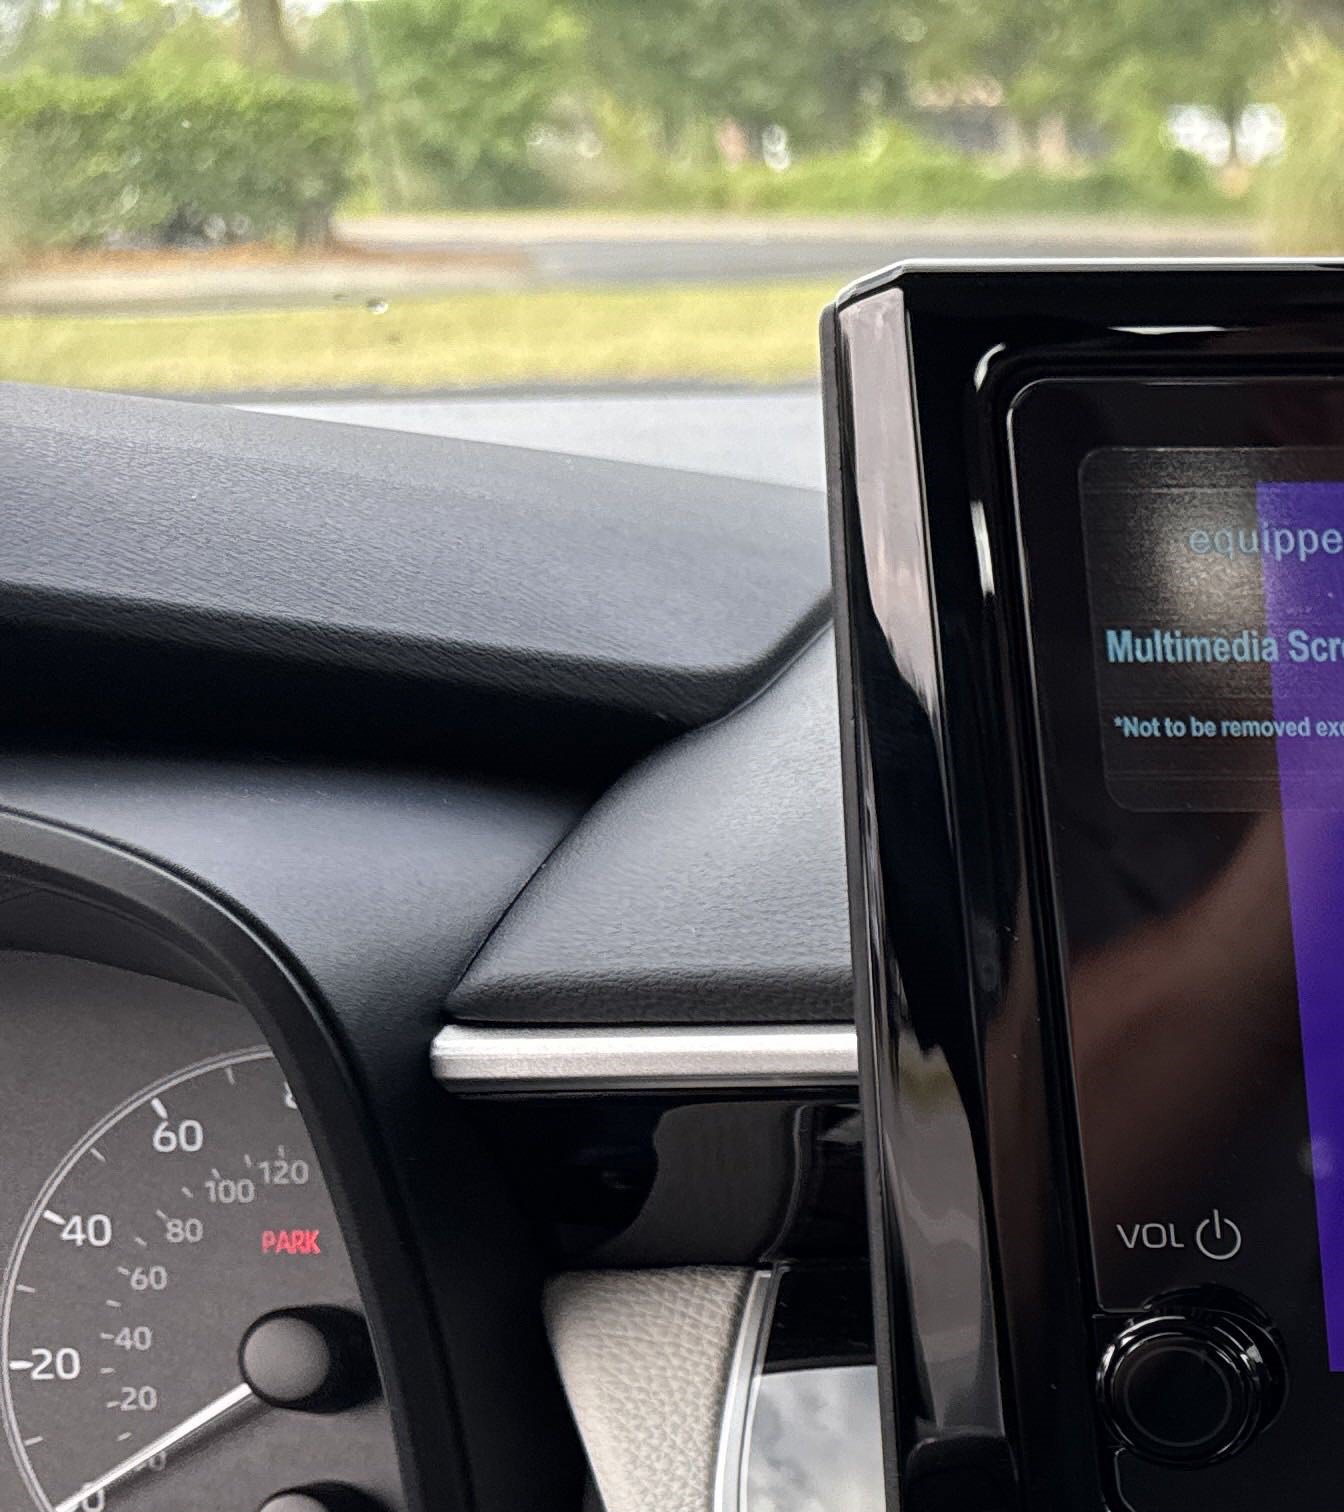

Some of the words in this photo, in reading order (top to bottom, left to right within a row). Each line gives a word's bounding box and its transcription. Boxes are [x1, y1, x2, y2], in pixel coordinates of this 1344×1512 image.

[1105, 629, 1279, 664] Multimedia
[1164, 718, 1186, 739] to
[1190, 717, 1216, 738] be
[1221, 716, 1311, 738] removed
[153, 1118, 204, 1152] 60
[257, 1160, 309, 1184] 120
[204, 1178, 255, 1204] 100
[60, 1213, 112, 1247] 40
[165, 1218, 203, 1243] 80
[261, 1229, 320, 1255] PARK
[1116, 1223, 1185, 1249] VOL
[129, 1265, 168, 1291] 60
[114, 1325, 153, 1351] 40
[31, 1346, 81, 1380] 20
[119, 1387, 158, 1411] 20
